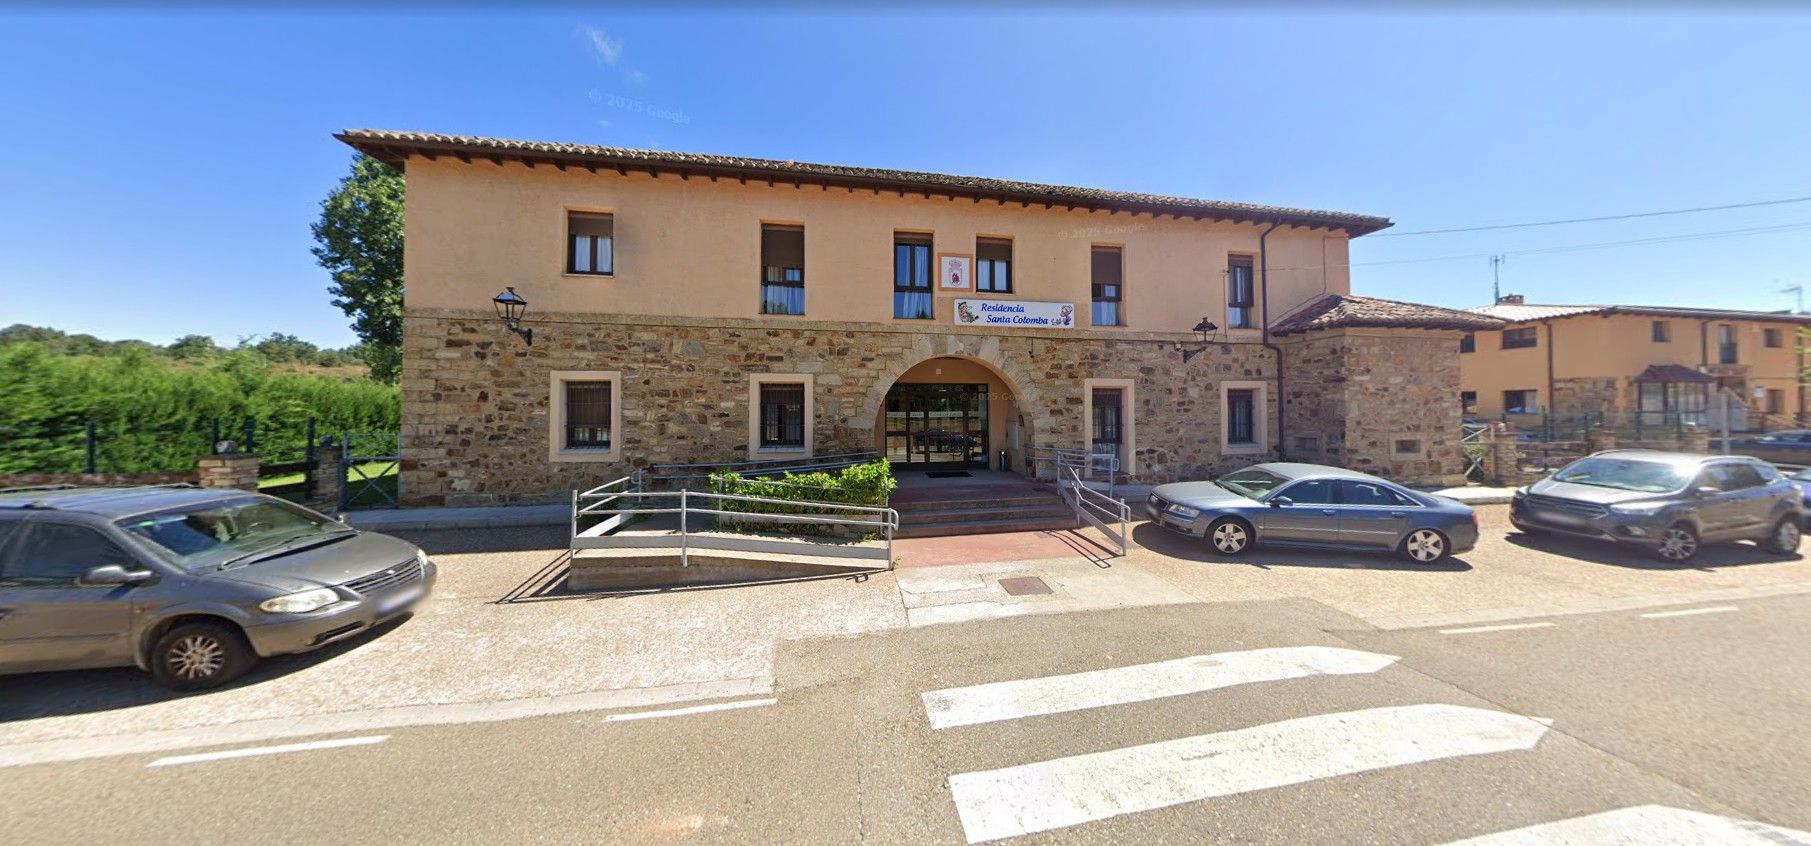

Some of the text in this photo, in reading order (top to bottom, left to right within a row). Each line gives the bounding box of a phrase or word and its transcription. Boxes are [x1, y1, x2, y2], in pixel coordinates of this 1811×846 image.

[981, 303, 1025, 313] Residencia
[986, 314, 1049, 325] Santa Colomba
